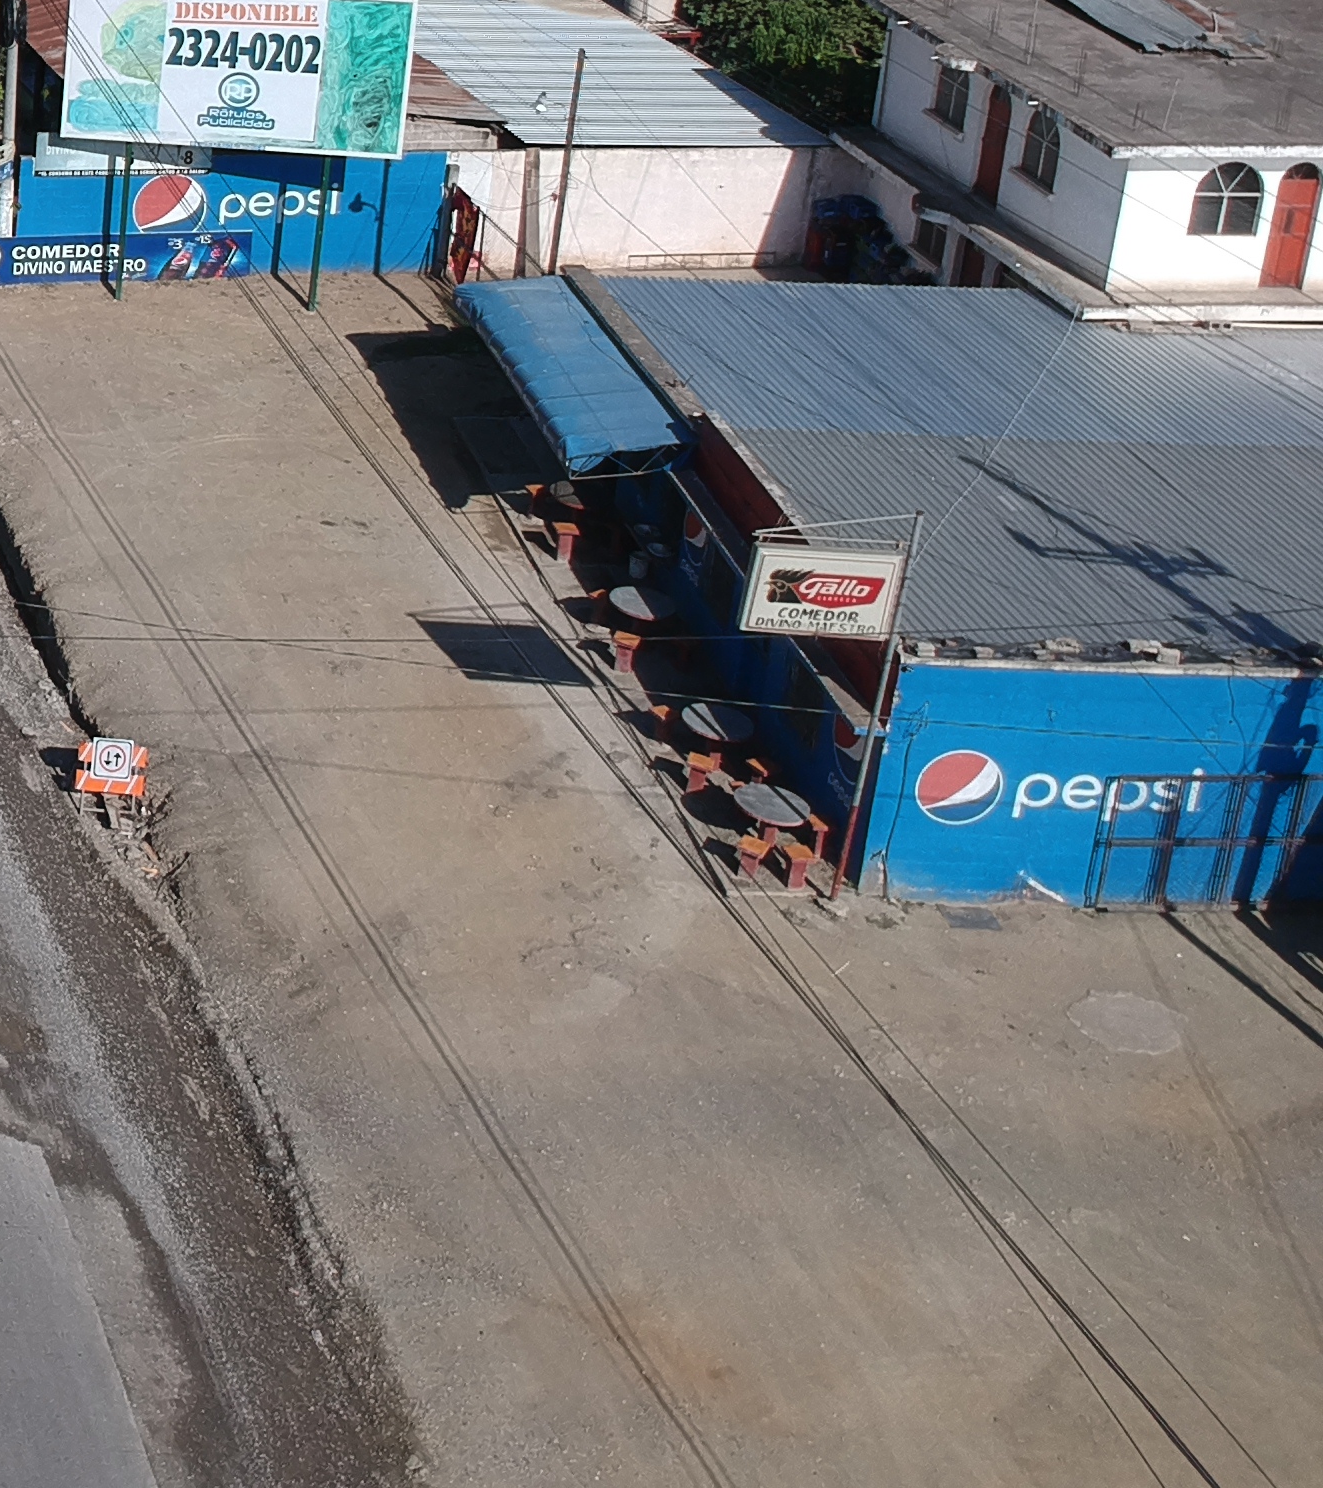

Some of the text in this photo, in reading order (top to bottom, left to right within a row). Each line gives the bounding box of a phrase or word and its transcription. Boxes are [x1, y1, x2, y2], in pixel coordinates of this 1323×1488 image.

[174, 1, 318, 22] DISPONIBLE
[165, 27, 321, 74] 2324-0202
[199, 116, 274, 129] Publicidad
[218, 181, 340, 225] pepsi
[11, 243, 120, 260] COMEDOR
[12, 261, 65, 276] DIVINO
[799, 577, 871, 600] Gallo
[755, 616, 802, 630] DIVINO
[778, 607, 860, 624] COMEDOR
[1011, 768, 1205, 823] pepsi
